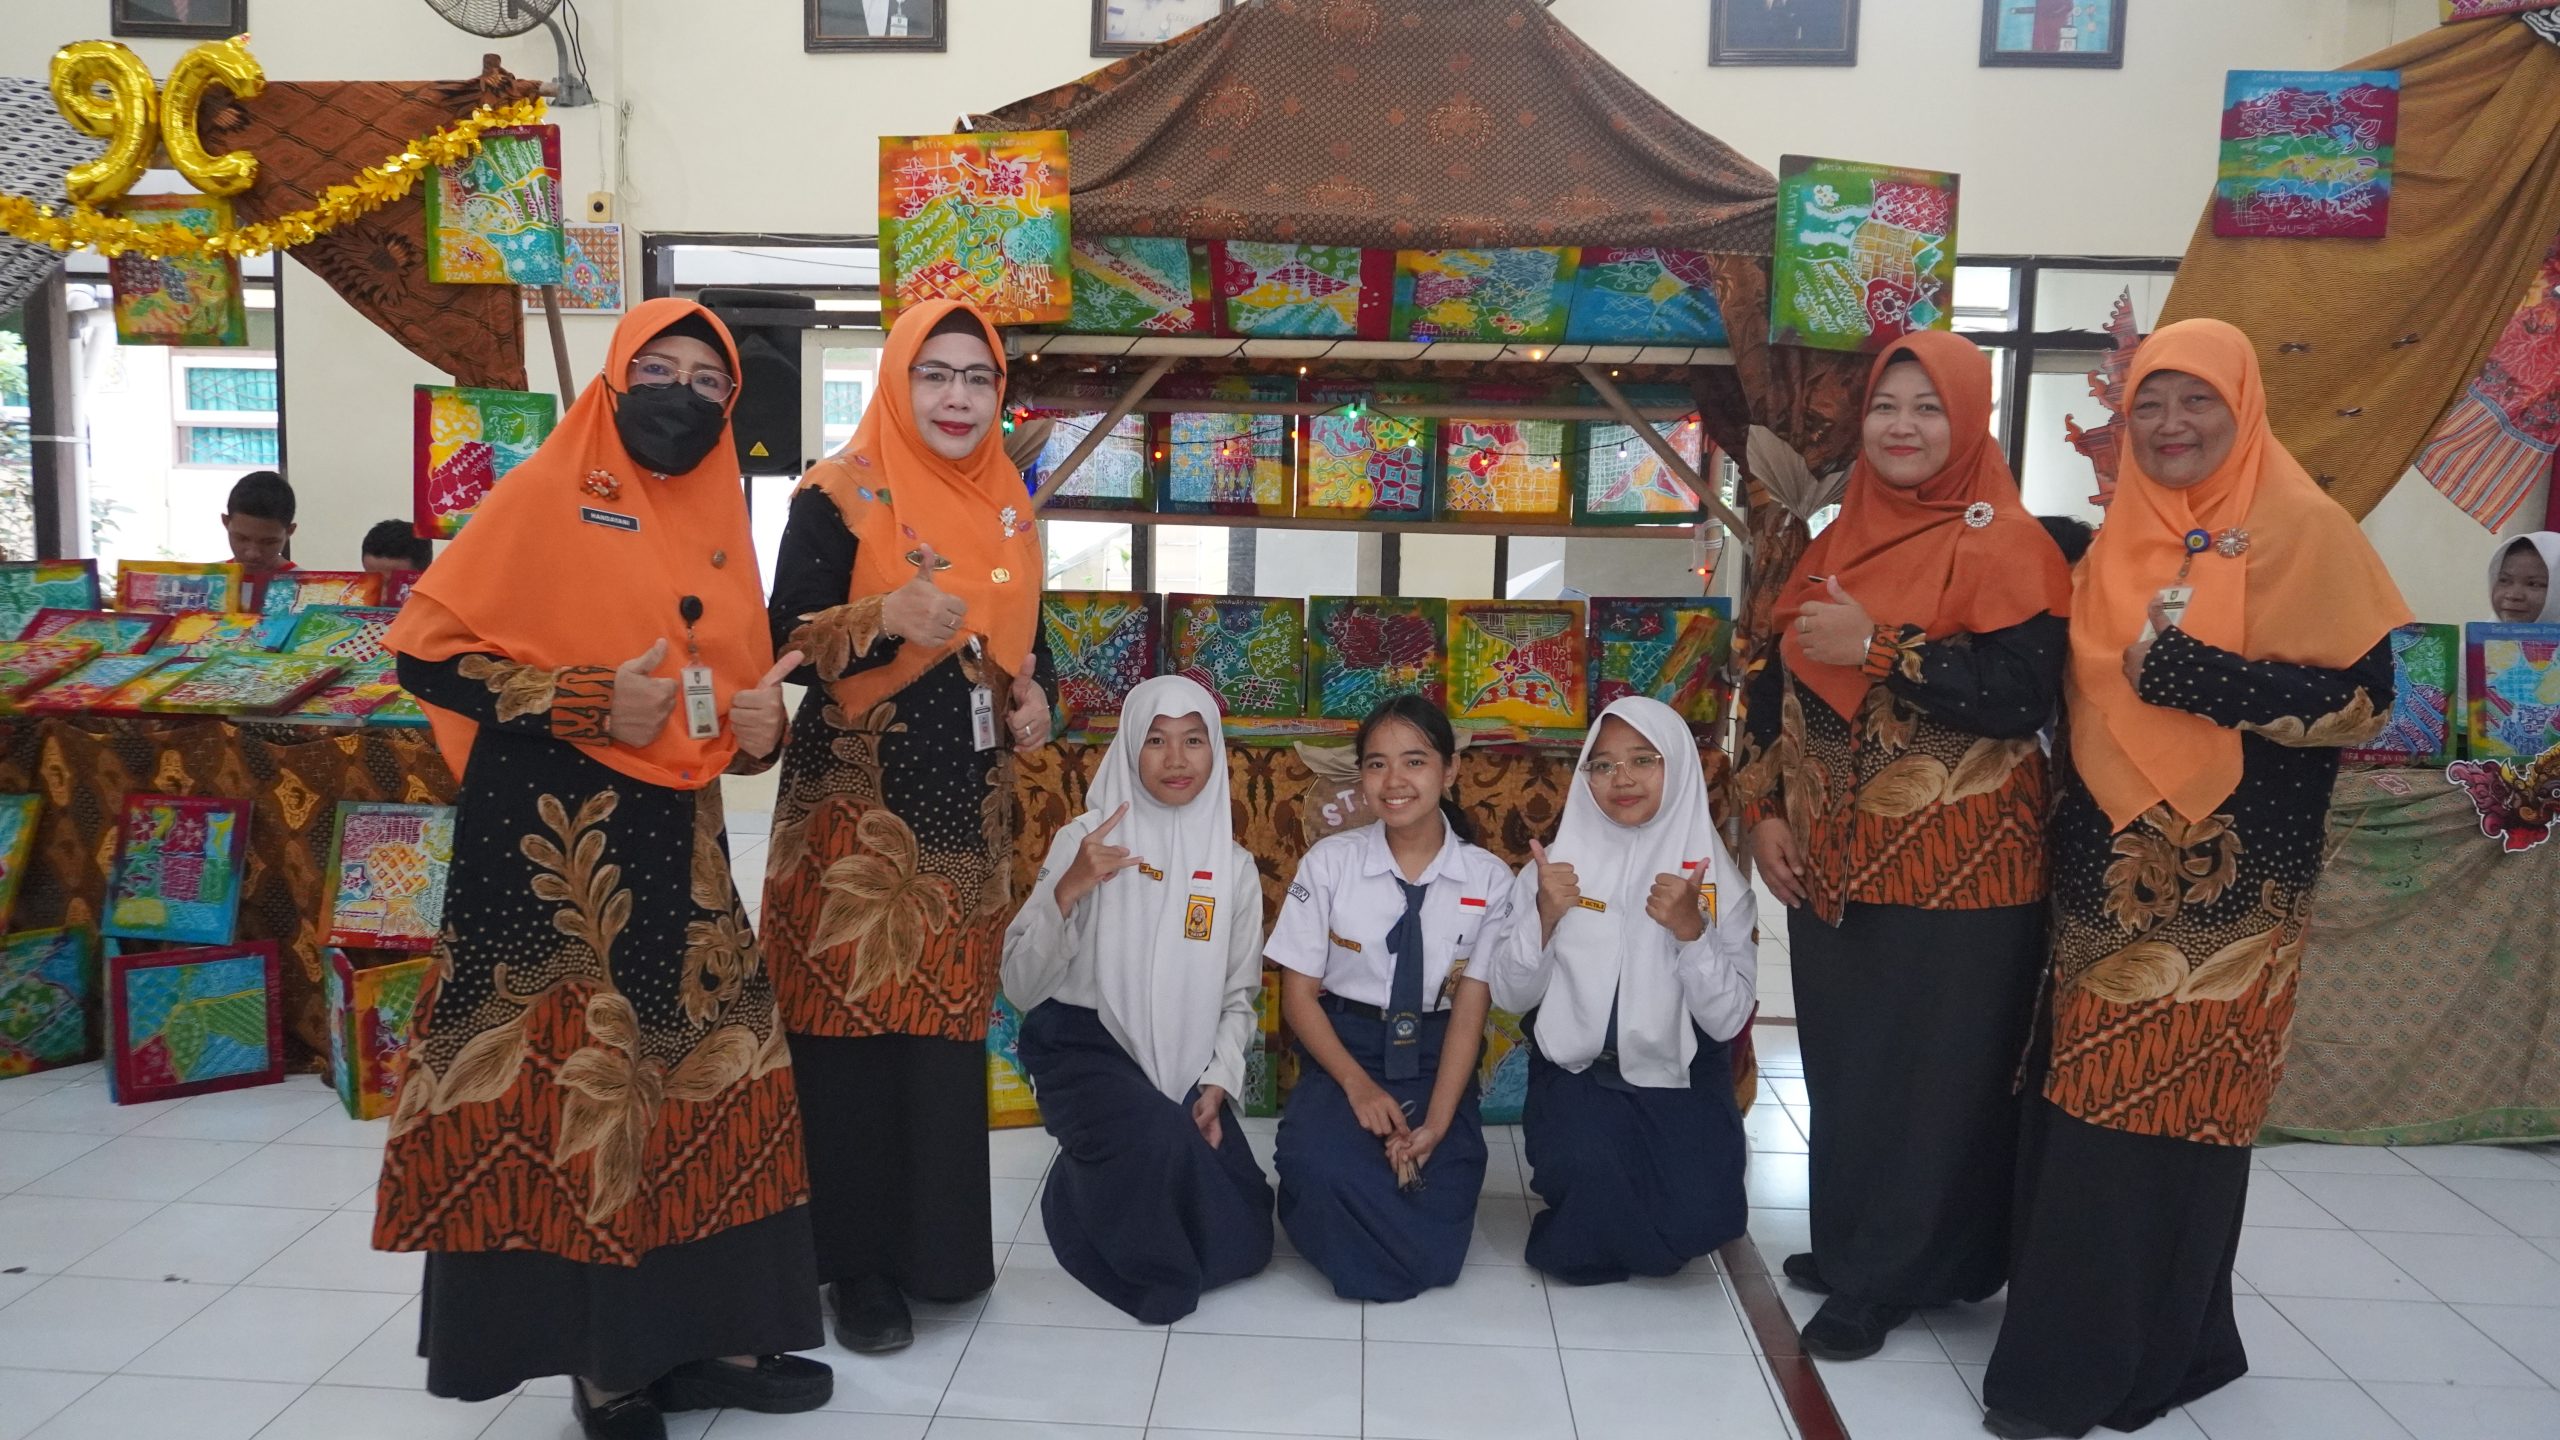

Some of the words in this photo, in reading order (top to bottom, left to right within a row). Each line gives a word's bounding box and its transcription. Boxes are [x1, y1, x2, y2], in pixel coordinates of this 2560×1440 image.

[48, 32, 267, 204] 9C
[912, 139, 947, 152] BATIK
[1322, 789, 1368, 826] ST
